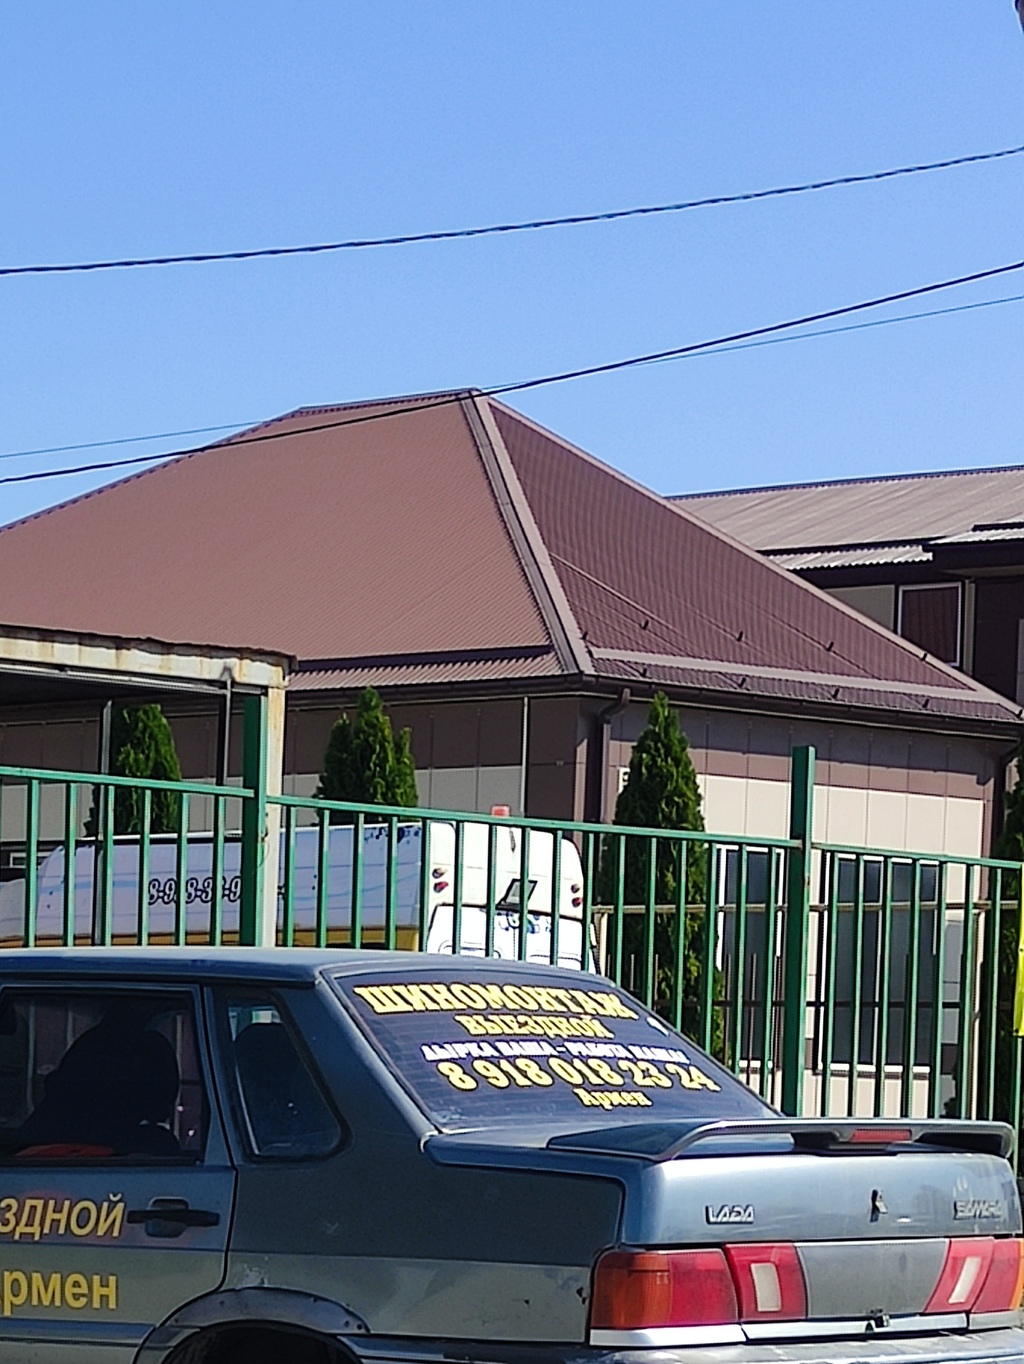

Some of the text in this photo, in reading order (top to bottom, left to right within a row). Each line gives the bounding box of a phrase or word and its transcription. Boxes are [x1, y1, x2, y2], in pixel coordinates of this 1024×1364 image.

[353, 982, 640, 1020] ШИНОМОНТАЖ
[453, 1013, 615, 1039] ВЫЕЗДНОЙ
[436, 1057, 722, 1092] 8 918 018 23 24
[573, 1087, 653, 1110] Армен
[705, 1204, 755, 1225] LADA
